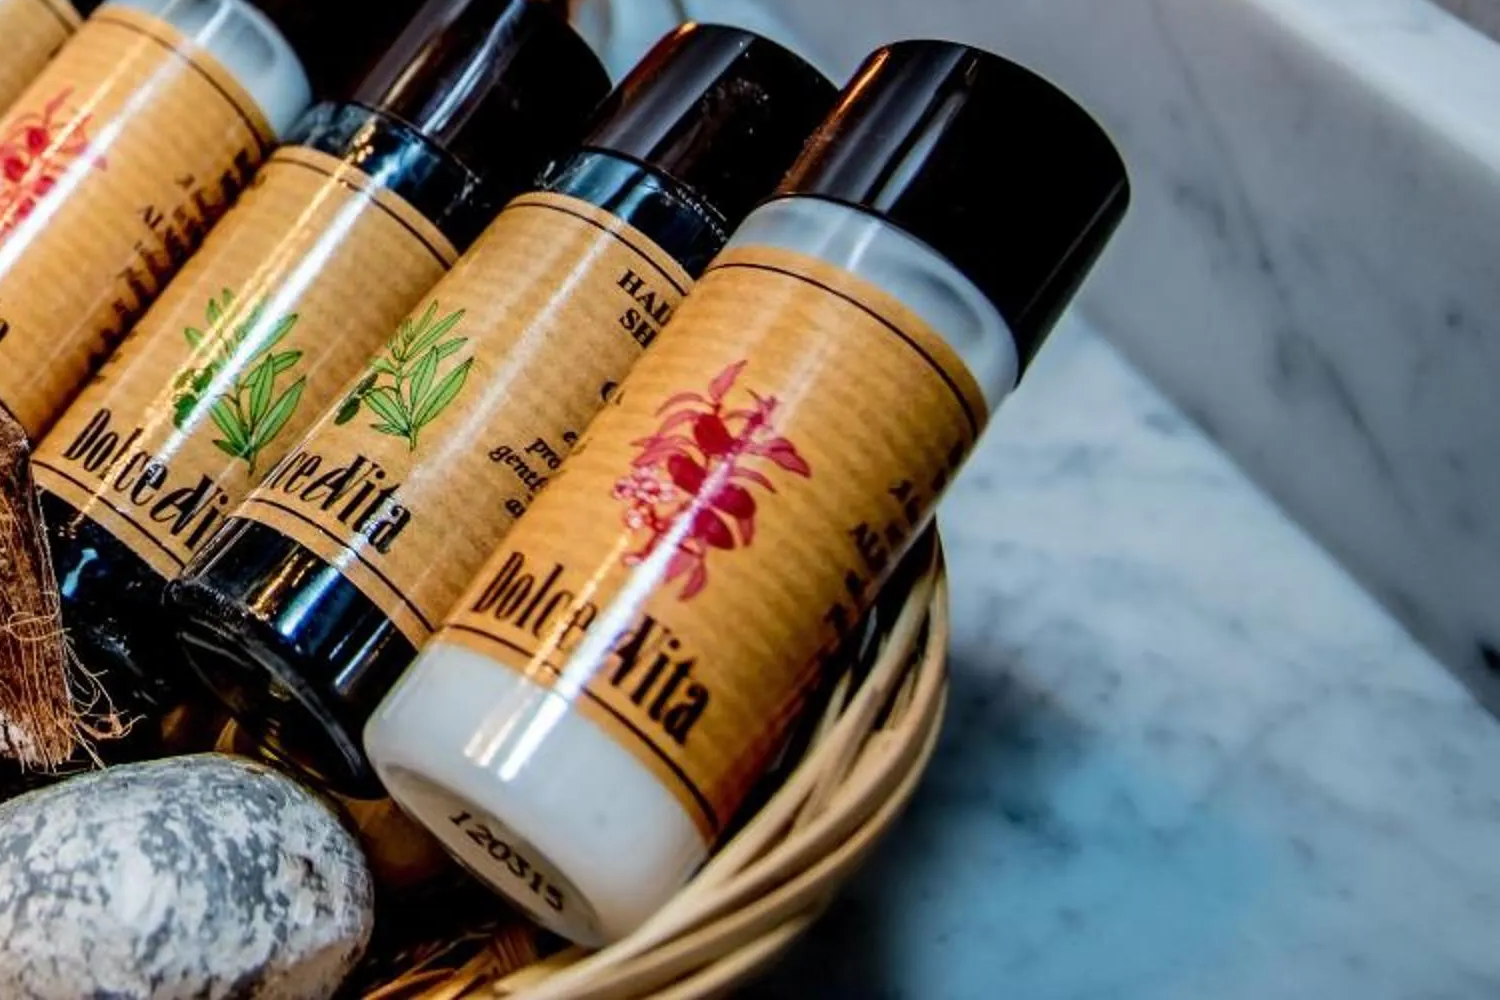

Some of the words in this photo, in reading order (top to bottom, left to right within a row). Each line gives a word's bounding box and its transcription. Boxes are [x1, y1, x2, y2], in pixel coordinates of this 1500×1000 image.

[523, 437, 562, 470] pro
[150, 472, 230, 550] Vi
[471, 551, 598, 650] Dolce
[448, 810, 565, 912] 120315
